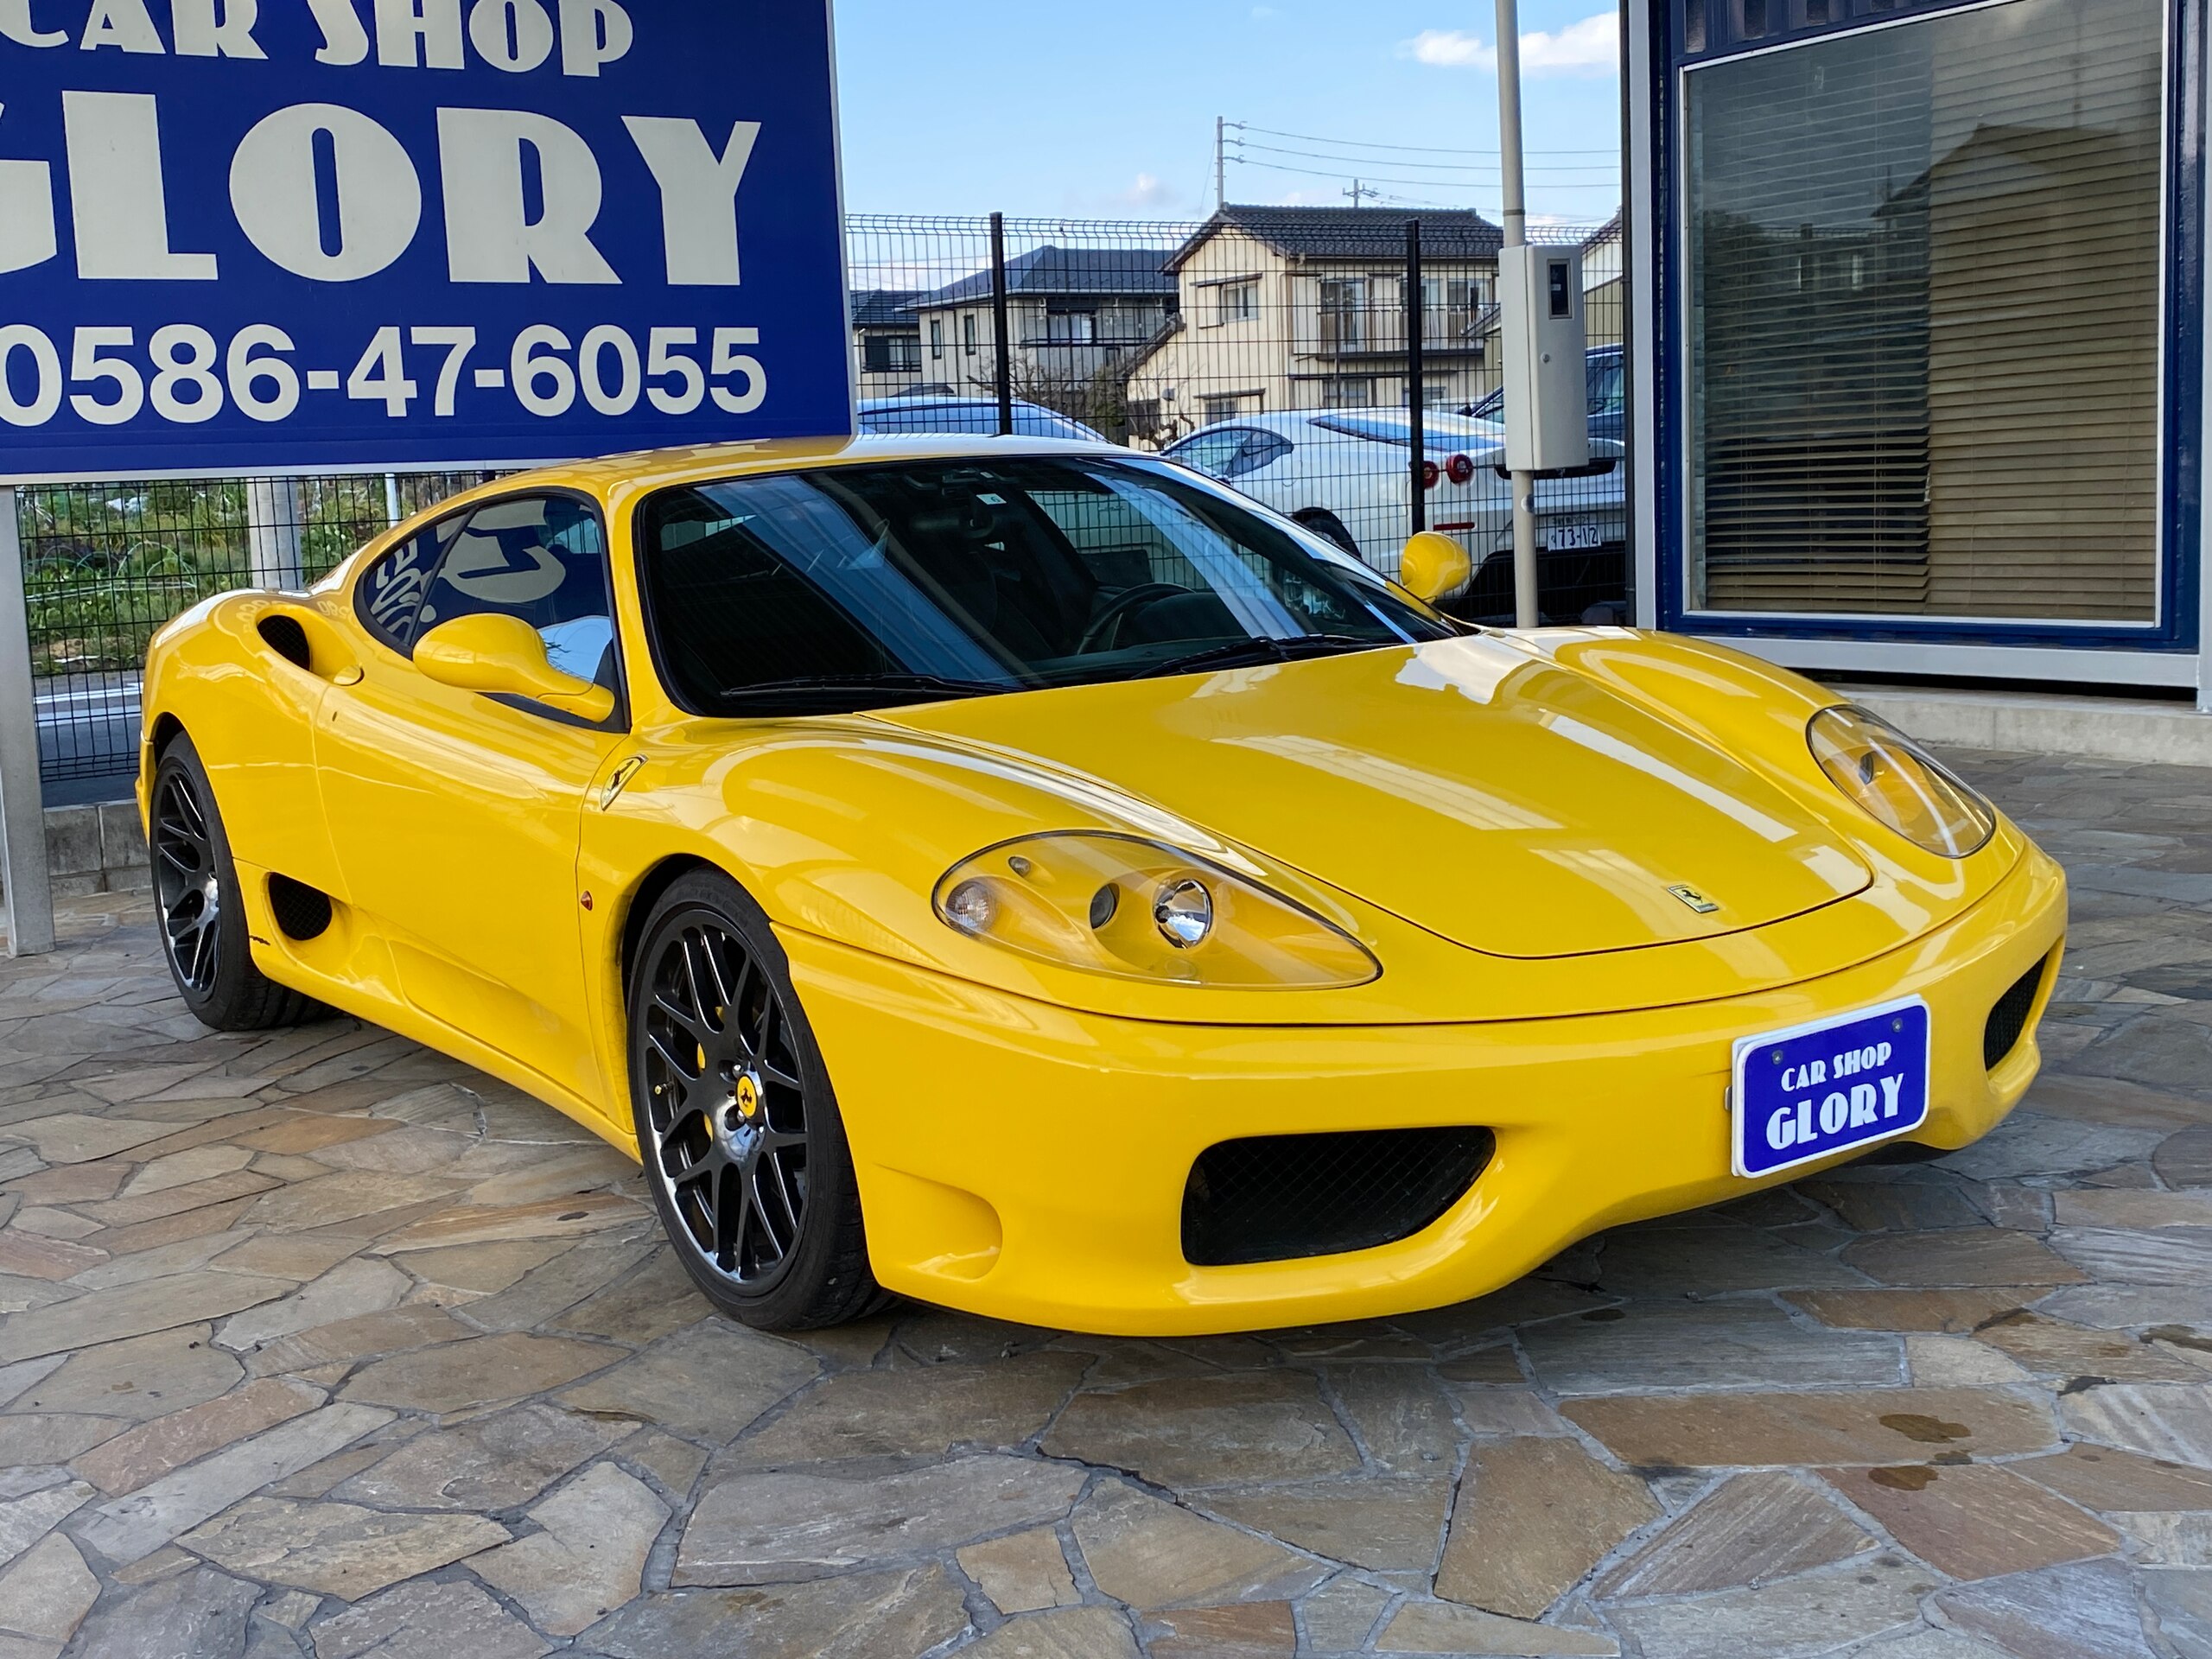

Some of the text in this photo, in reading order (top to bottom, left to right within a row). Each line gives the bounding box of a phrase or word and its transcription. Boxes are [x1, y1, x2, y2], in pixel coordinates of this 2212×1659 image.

[307, 0, 633, 76] SHOP
[0, 90, 762, 286] LORY
[0, 323, 767, 427] 0586-47-6055
[1781, 1041, 1892, 1092] CAR SHOP
[1766, 1073, 1904, 1150] GLORY
